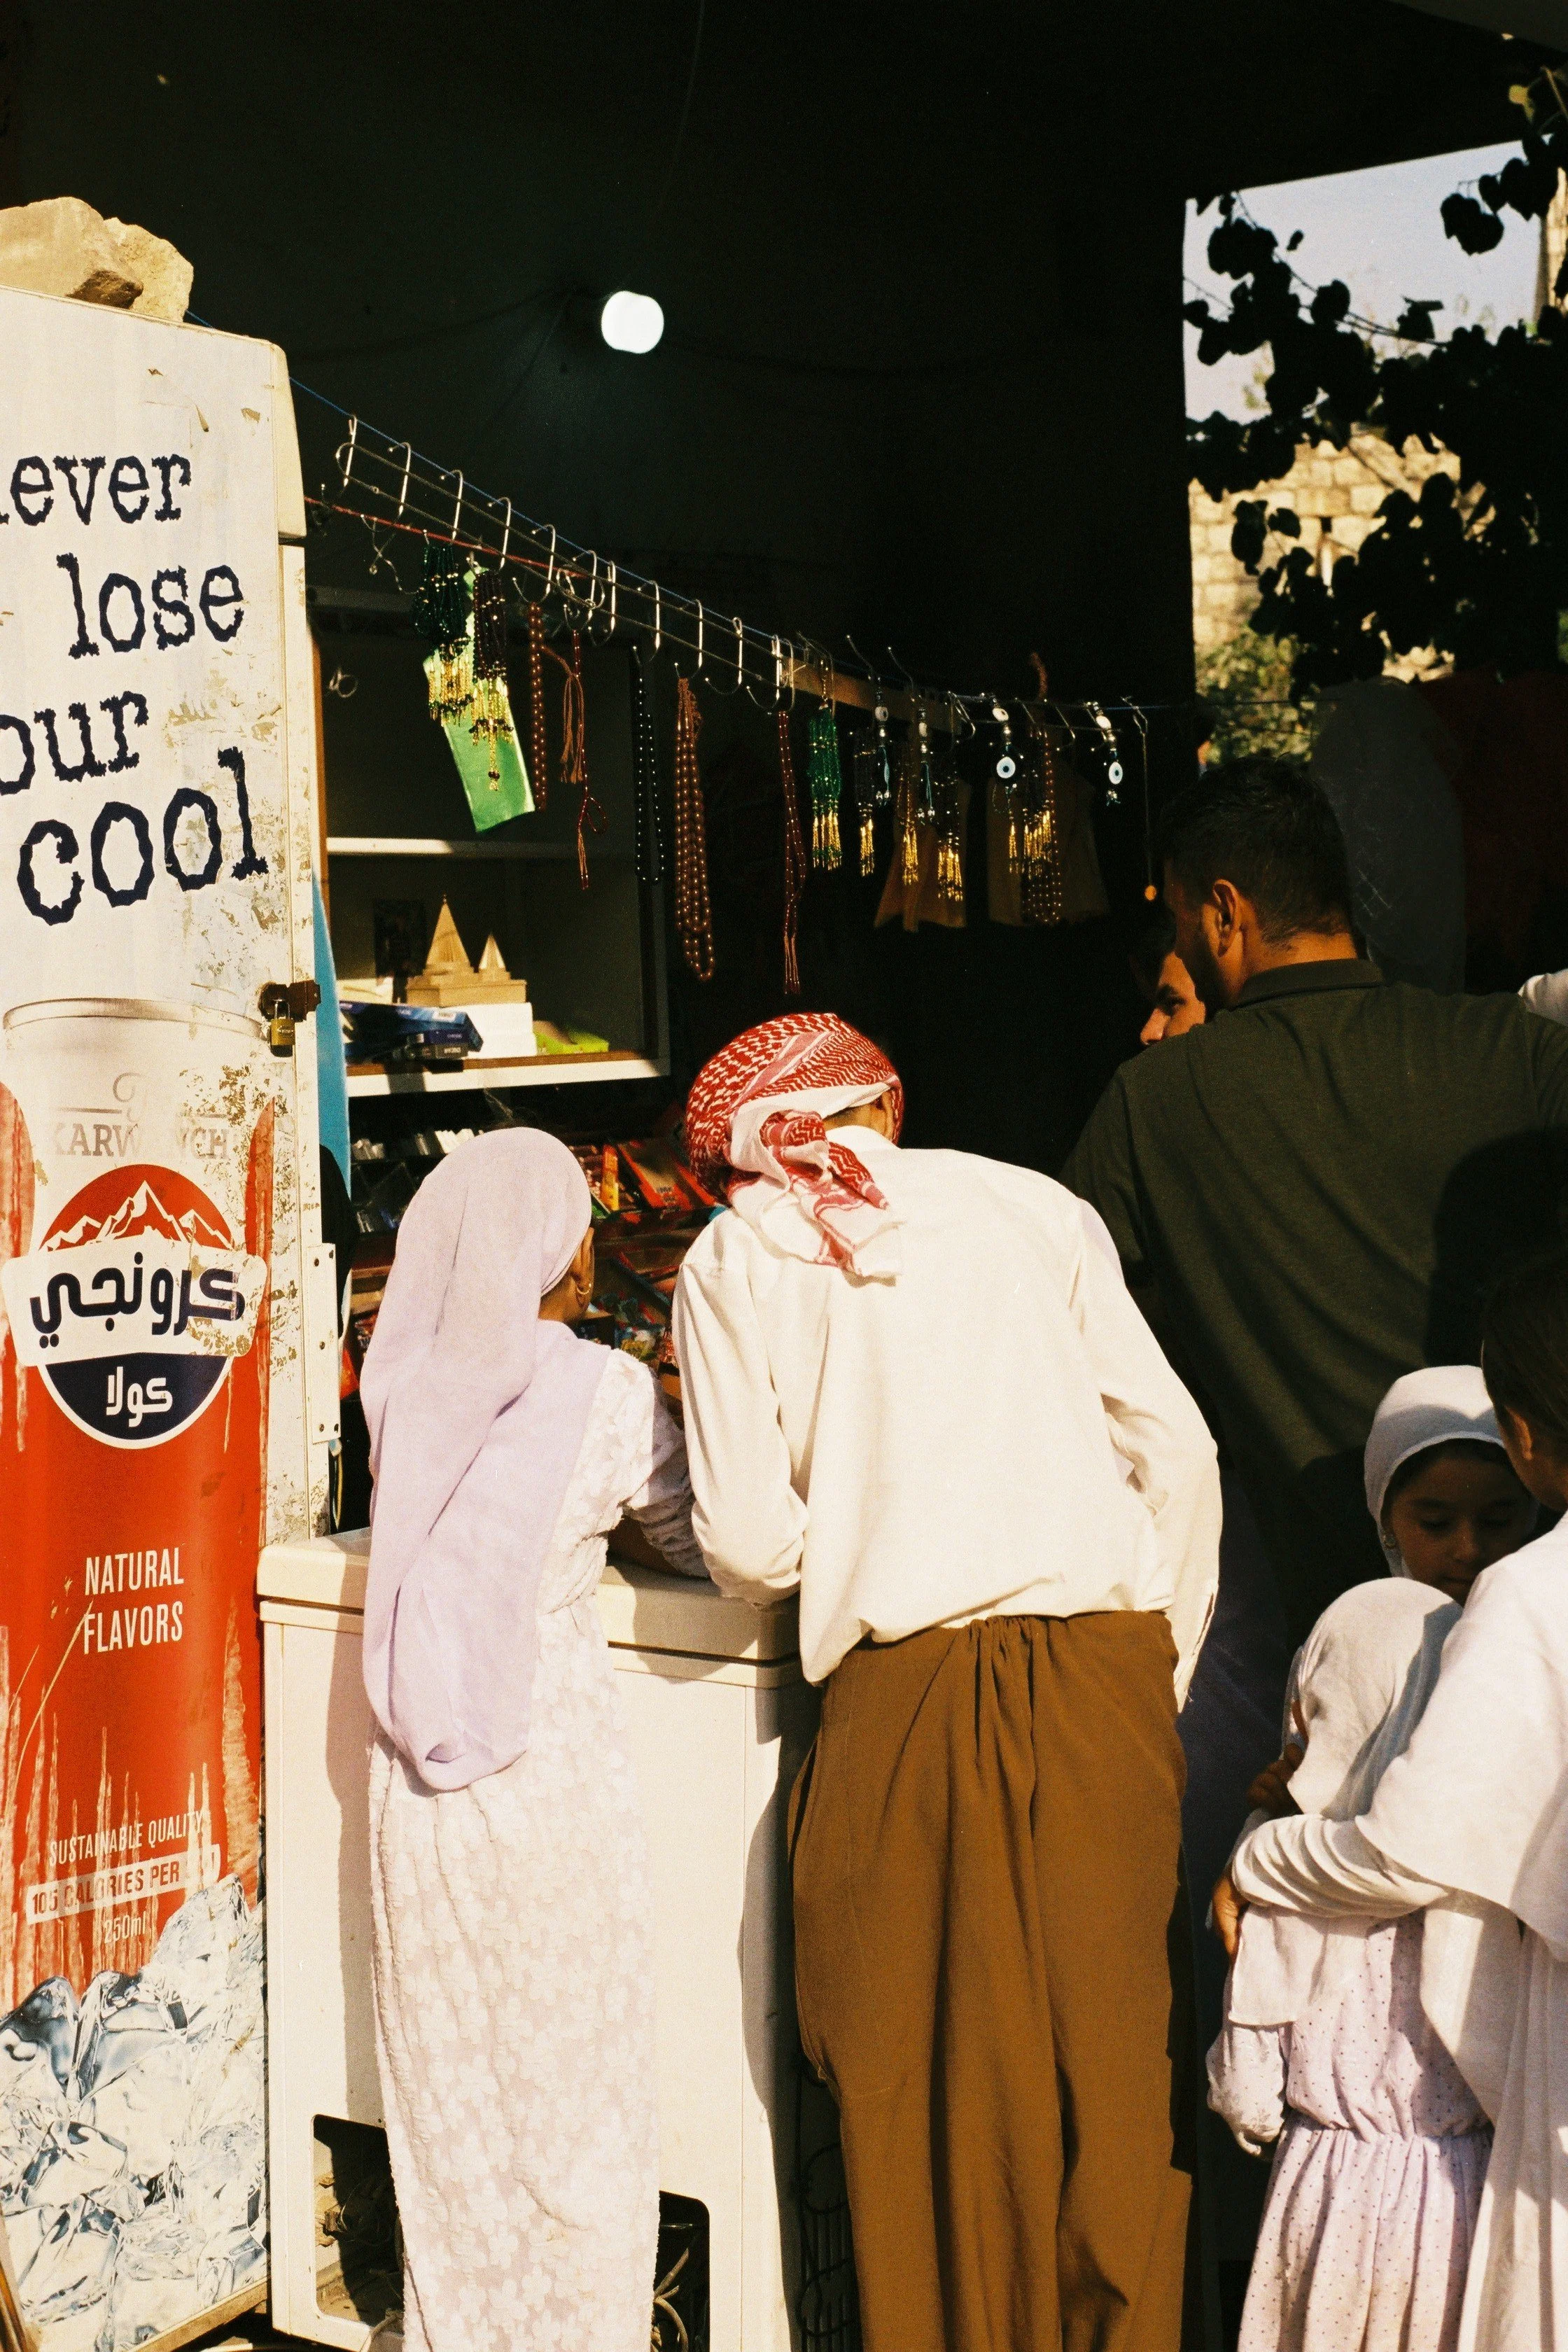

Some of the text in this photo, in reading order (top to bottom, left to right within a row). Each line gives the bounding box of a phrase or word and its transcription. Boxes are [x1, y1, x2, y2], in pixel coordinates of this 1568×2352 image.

[0, 454, 191, 526] ever
[56, 552, 244, 659] lose
[17, 746, 269, 926] cool
[106, 1366, 173, 1427] كولا
[85, 1547, 184, 1596] NATURAL
[83, 1600, 183, 1655] FLAVORS
[49, 1823, 144, 1867] SUSTAINABLE
[32, 1861, 180, 1915] 105 CALORIES PER
[104, 1910, 146, 1945] 250ml
